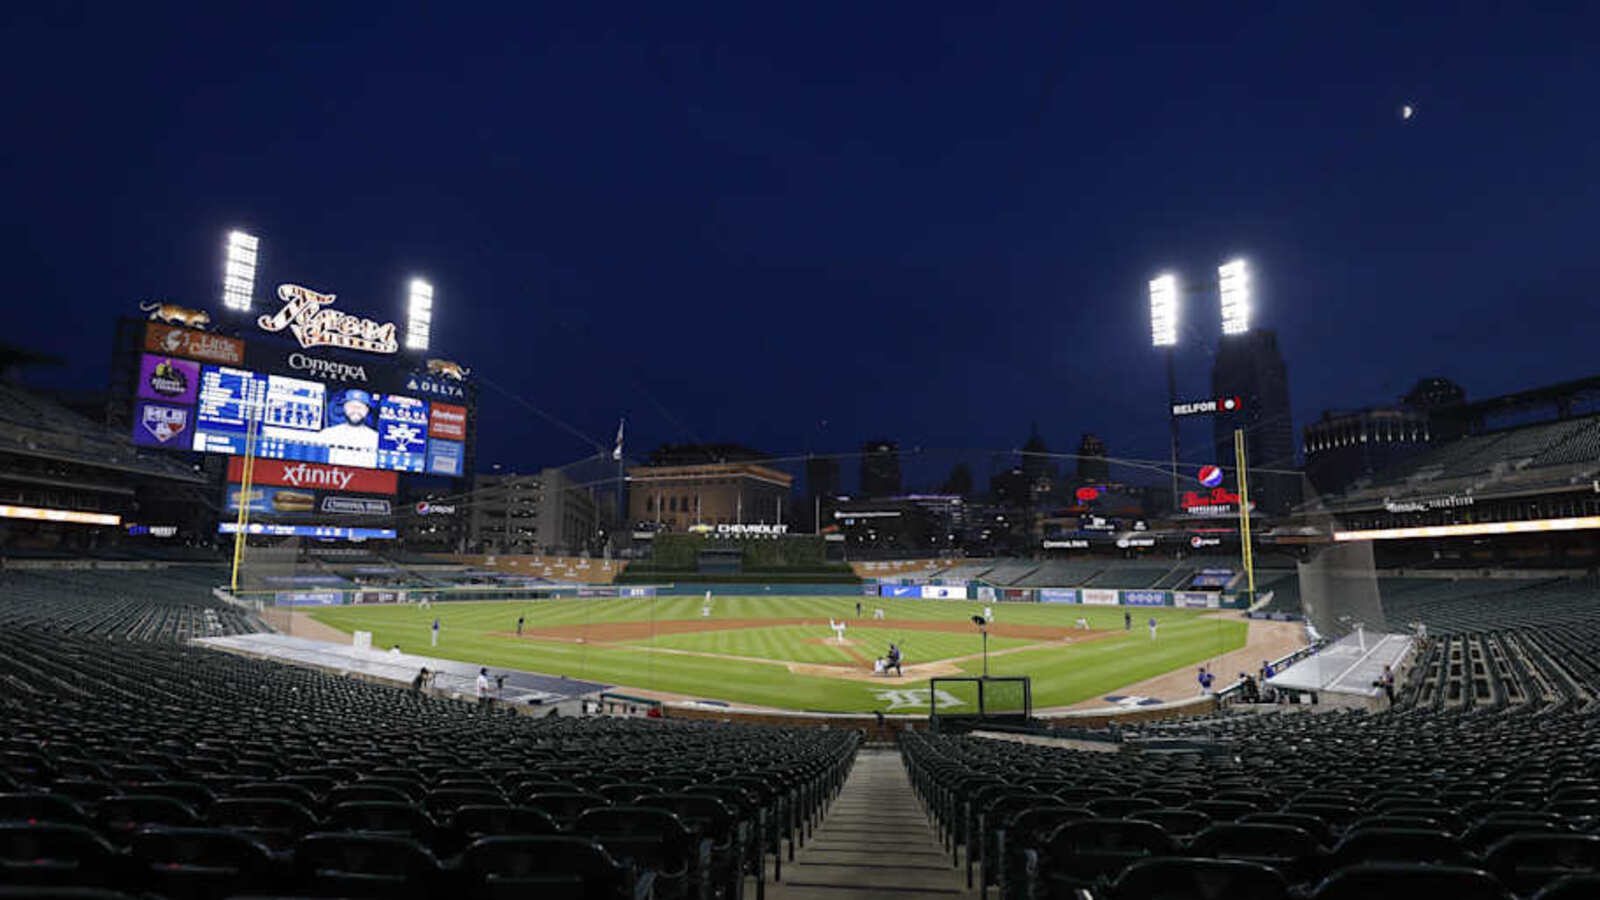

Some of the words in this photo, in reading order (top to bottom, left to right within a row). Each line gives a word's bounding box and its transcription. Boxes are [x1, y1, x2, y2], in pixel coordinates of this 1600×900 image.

[421, 379, 463, 397] DELTA
[1172, 401, 1217, 415] BELFOR
[281, 463, 353, 489] xfinity
[717, 524, 788, 535] CHEVROLET
